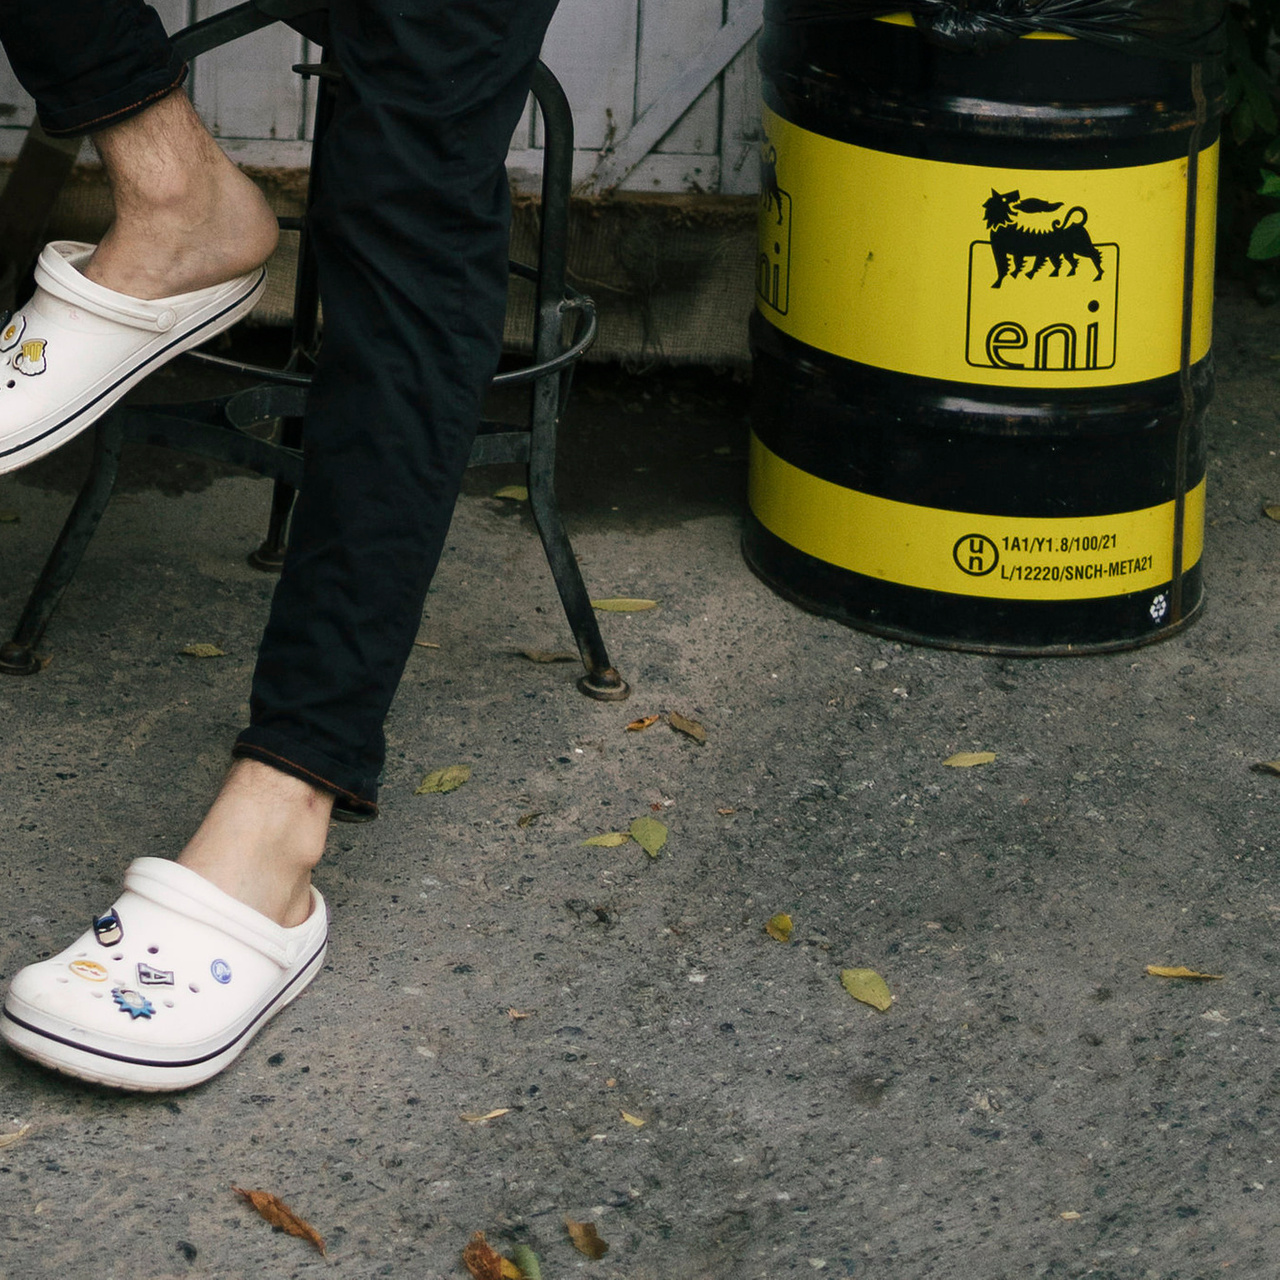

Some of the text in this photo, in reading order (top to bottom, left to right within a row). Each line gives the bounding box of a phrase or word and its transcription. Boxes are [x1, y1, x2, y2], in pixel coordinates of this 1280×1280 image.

[985, 299, 1100, 370] eni
[1001, 533, 1117, 554] 1A1/Y1.8/100/21
[1000, 555, 1153, 582] L/12220/SNCH-META21
